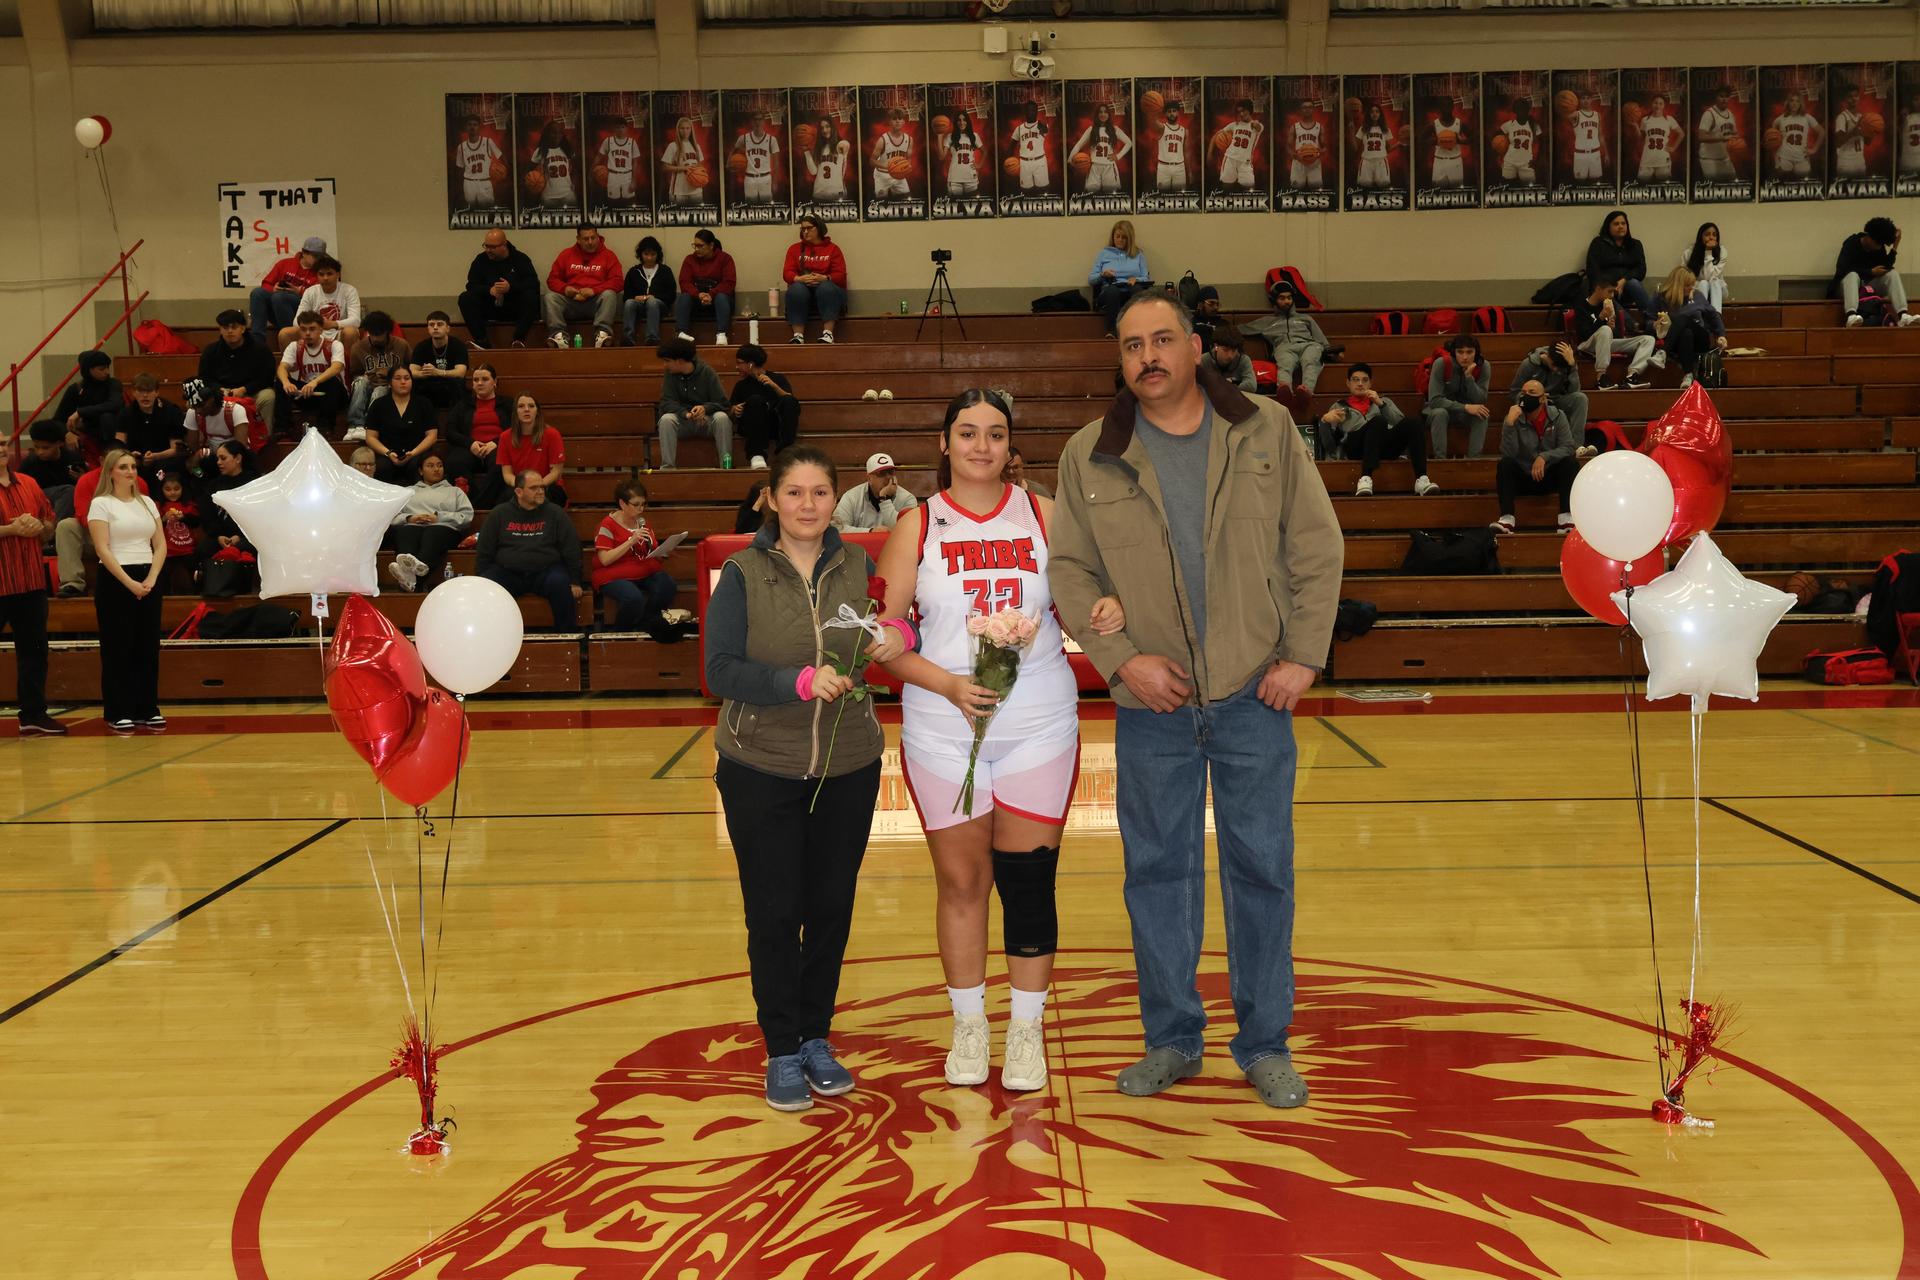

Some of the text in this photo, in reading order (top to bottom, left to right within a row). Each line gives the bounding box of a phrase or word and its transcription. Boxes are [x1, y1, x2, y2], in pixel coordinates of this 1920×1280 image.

[259, 187, 322, 209] THAT
[1206, 198, 1269, 211] ESCHEIK
[1281, 196, 1330, 209] BASS
[1352, 195, 1404, 209] BASS
[1417, 194, 1478, 207] HEMPHILL
[1485, 191, 1547, 205] MOORE
[868, 204, 923, 219] SMITH
[932, 202, 993, 218] SILVA
[1000, 200, 1064, 216] VAUGHN
[1069, 200, 1131, 213] MARION
[1137, 199, 1200, 212] ESCHEIK
[451, 212, 512, 225] AGUILAR
[520, 212, 581, 225] CARTER
[588, 212, 651, 225] WALTERS
[658, 210, 717, 225] NEWTON
[727, 209, 789, 222] BEARDSLEY
[223, 191, 245, 287] TAKE
[878, 456, 889, 465] C
[940, 537, 1039, 576] TRIBE
